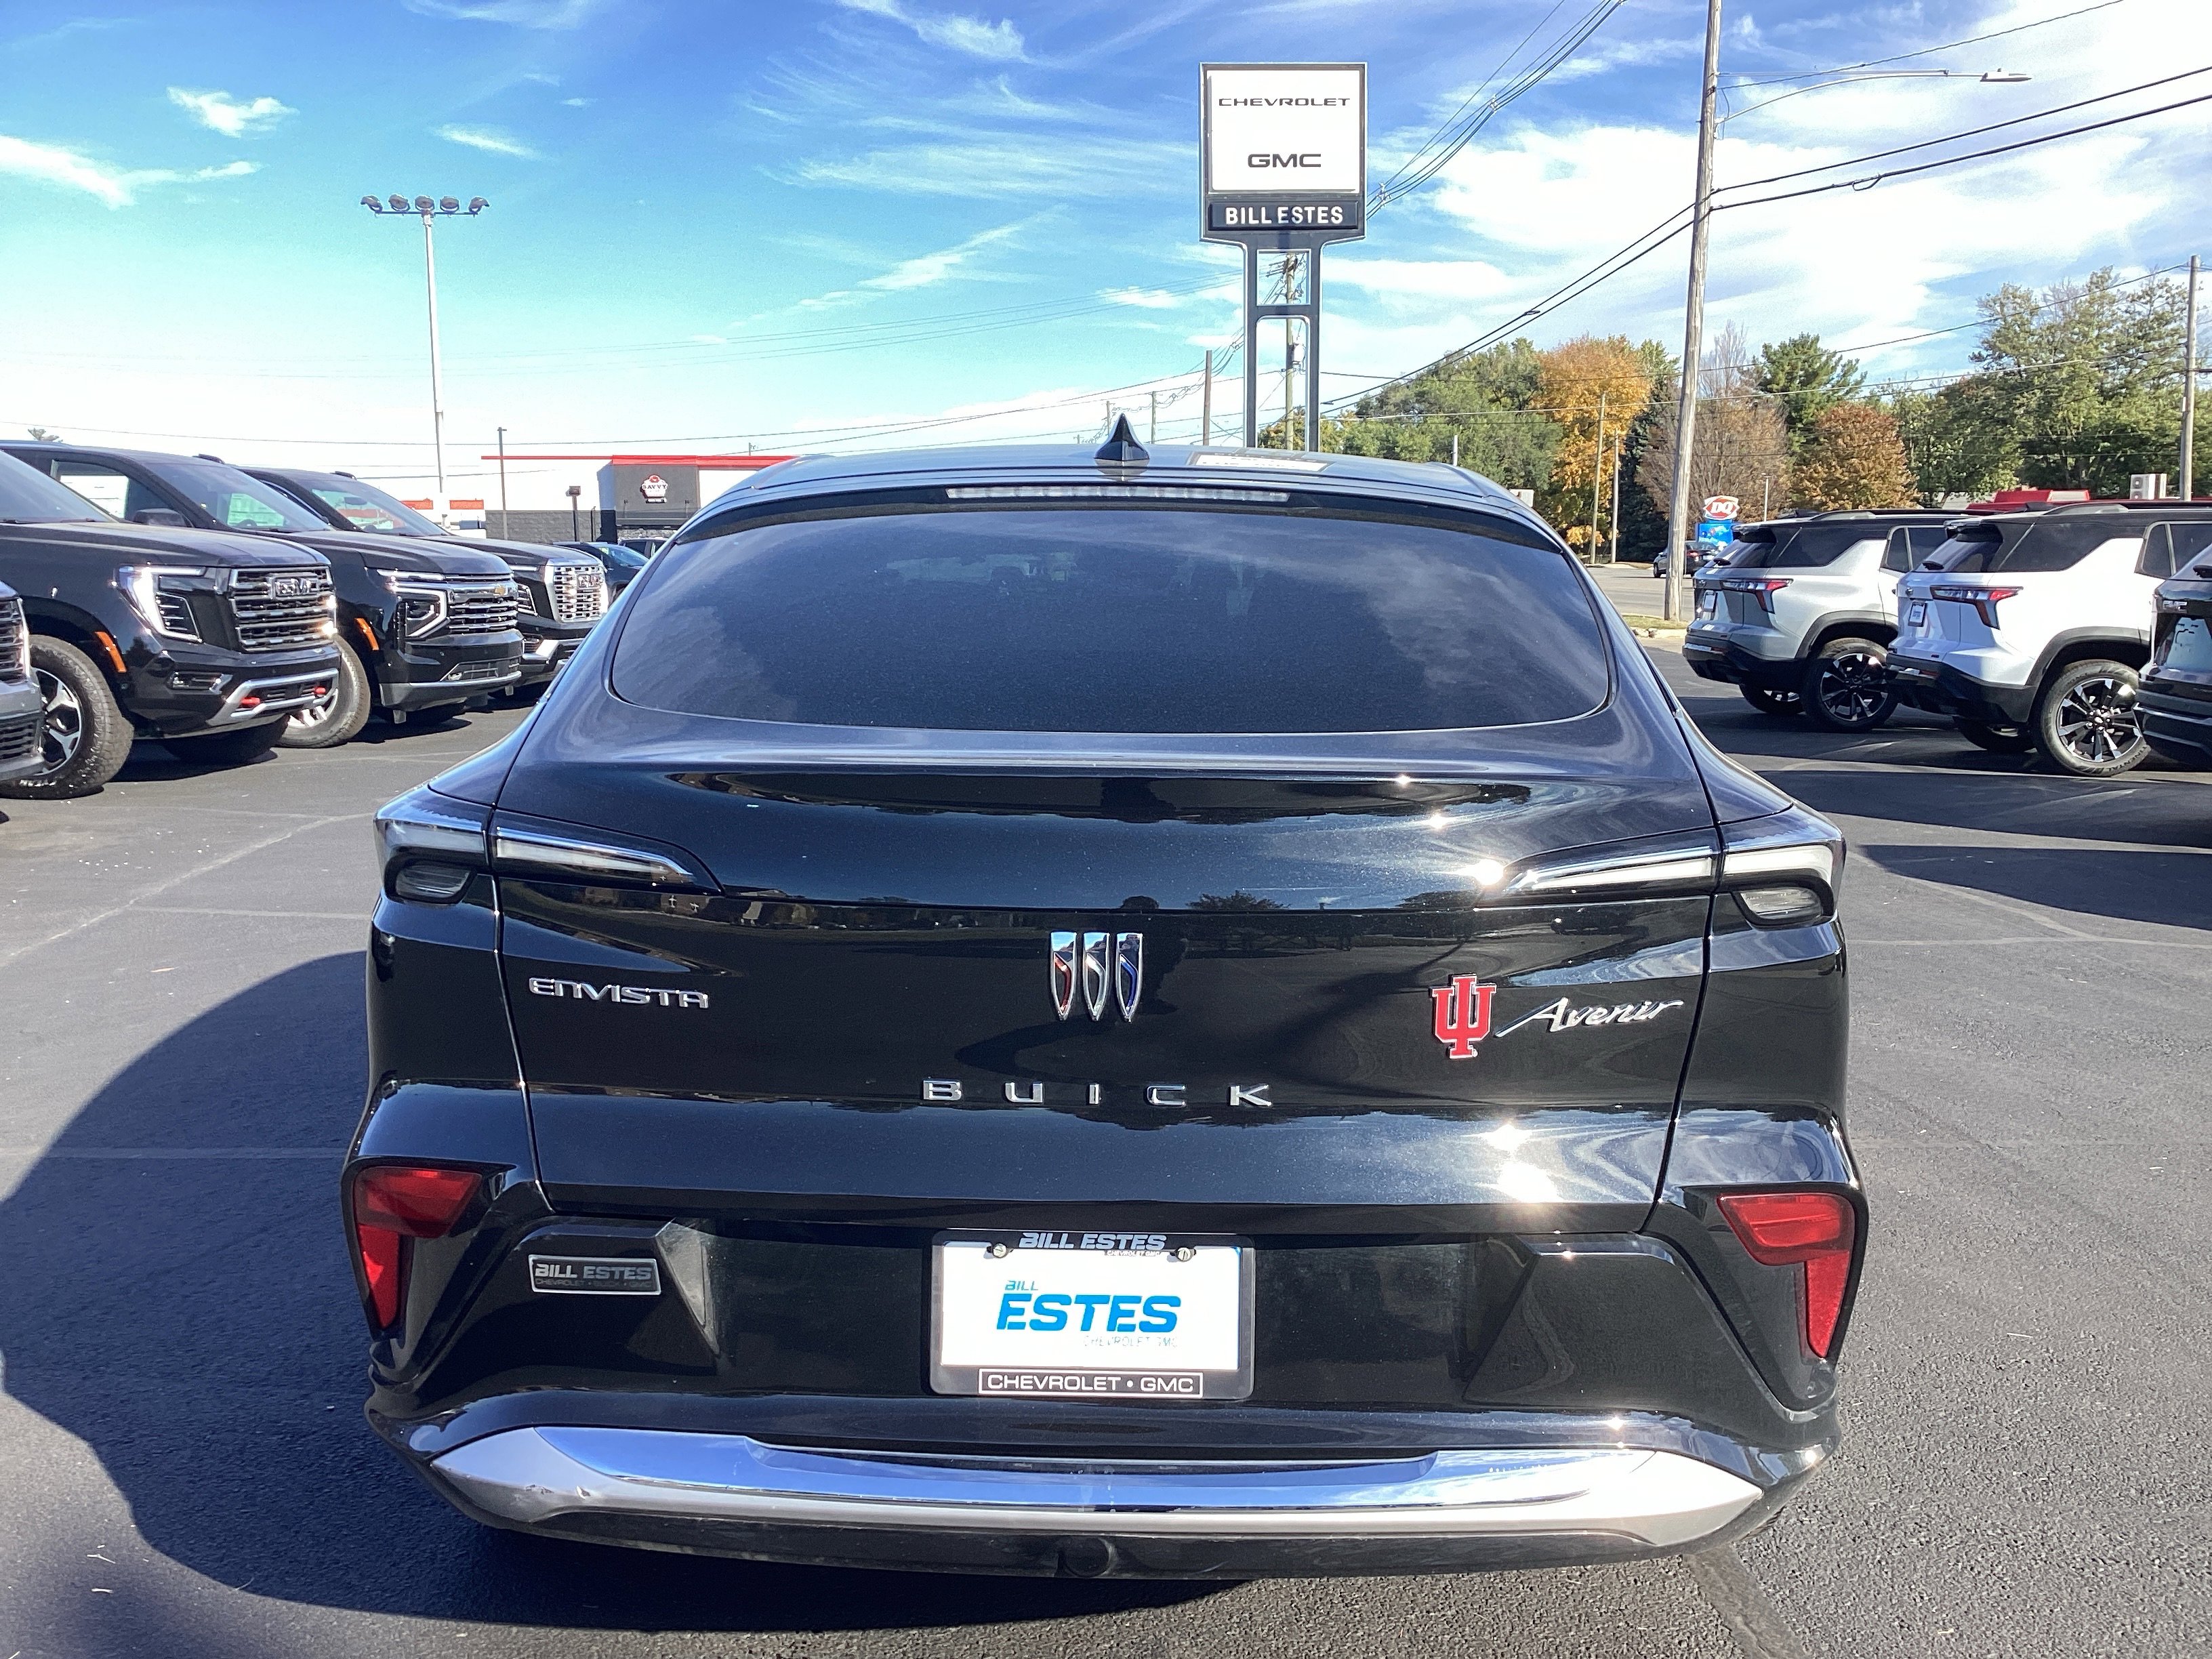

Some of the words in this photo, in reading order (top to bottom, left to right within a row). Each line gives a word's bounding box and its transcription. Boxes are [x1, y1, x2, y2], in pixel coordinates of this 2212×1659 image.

[1218, 98, 1351, 106] CHEVROLET
[1248, 153, 1321, 168] GMC
[1225, 206, 1272, 224] BILL
[1277, 206, 1343, 224] ESTES
[1710, 501, 1735, 514] DQ
[529, 977, 709, 1009] ENVISTA
[1494, 996, 1685, 1039] Avenir
[923, 1079, 1273, 1107] BUICK
[1019, 1232, 1075, 1248] BILL
[1080, 1233, 1167, 1250] ESTES
[535, 1263, 577, 1278] BILL
[583, 1265, 653, 1280] ESTES
[1005, 1279, 1039, 1291] BILL
[996, 1293, 1181, 1333] ESTES
[987, 1374, 1122, 1390] CHEVROLET
[1140, 1377, 1194, 1392] GMC
